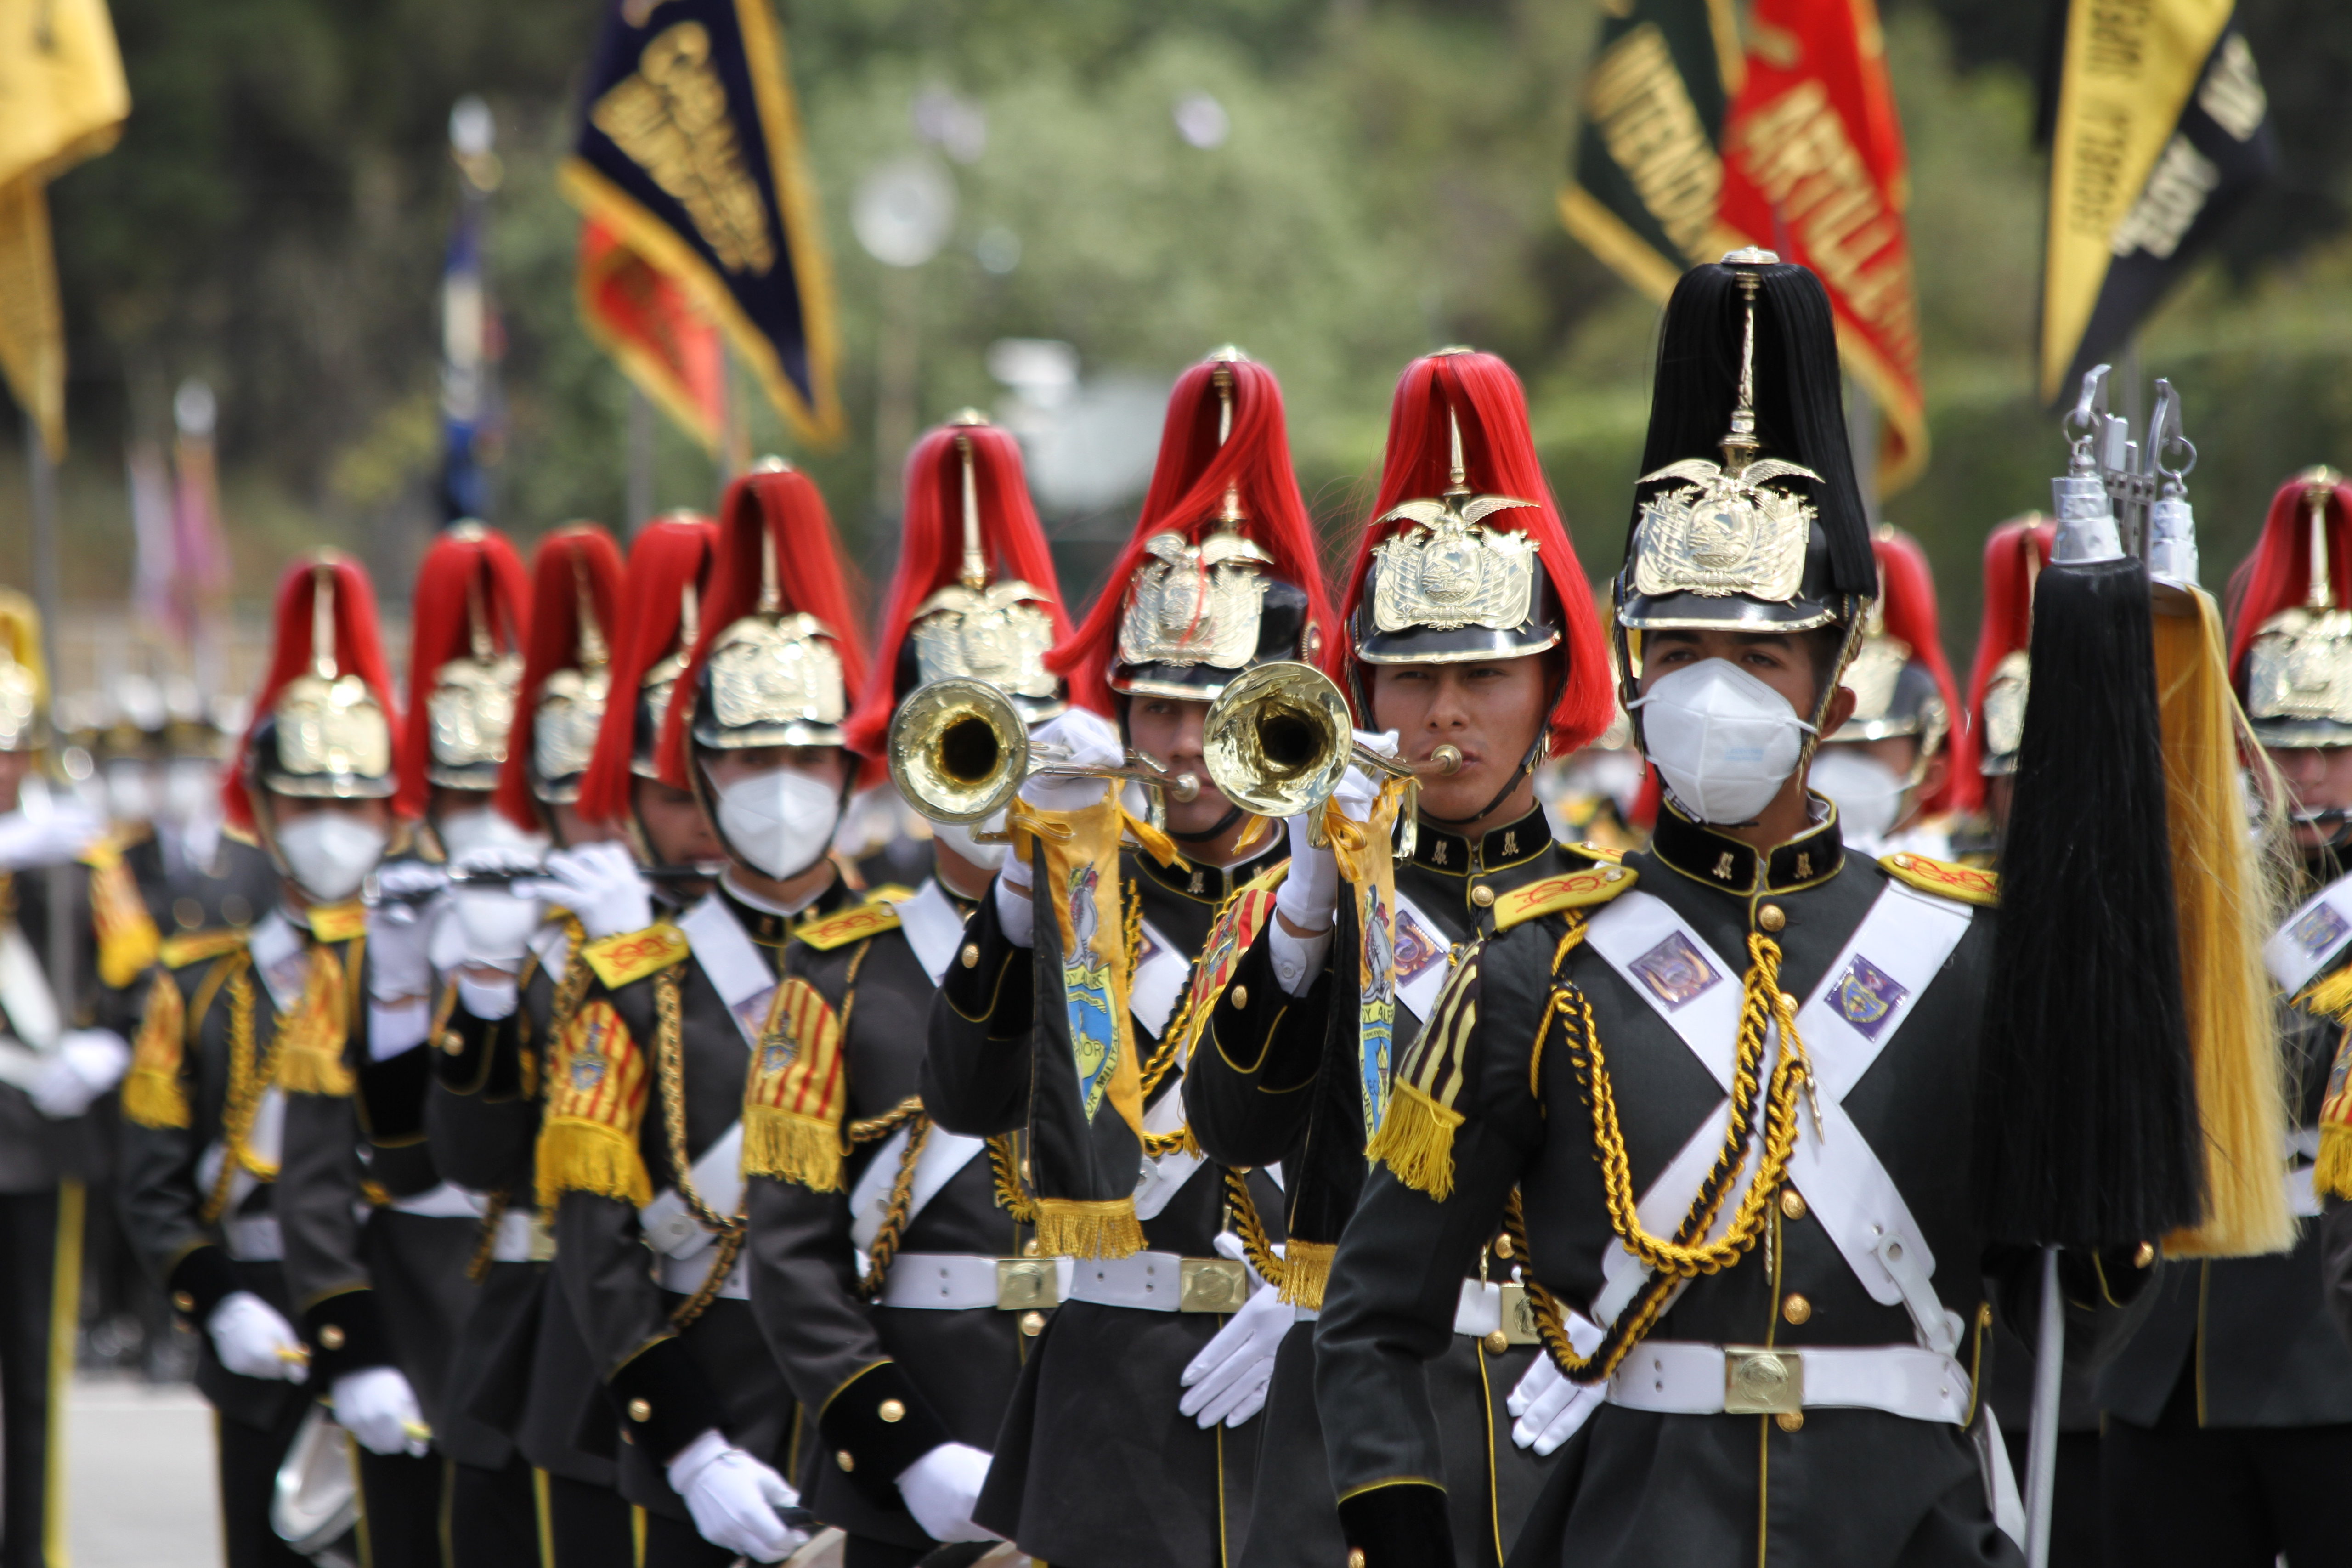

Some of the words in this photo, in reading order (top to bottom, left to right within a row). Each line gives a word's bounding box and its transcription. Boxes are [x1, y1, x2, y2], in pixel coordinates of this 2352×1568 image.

[2083, 0, 2153, 81] SUPE
[1361, 1008, 1371, 1022] OY
[1096, 1026, 1118, 1089] MILITAR
